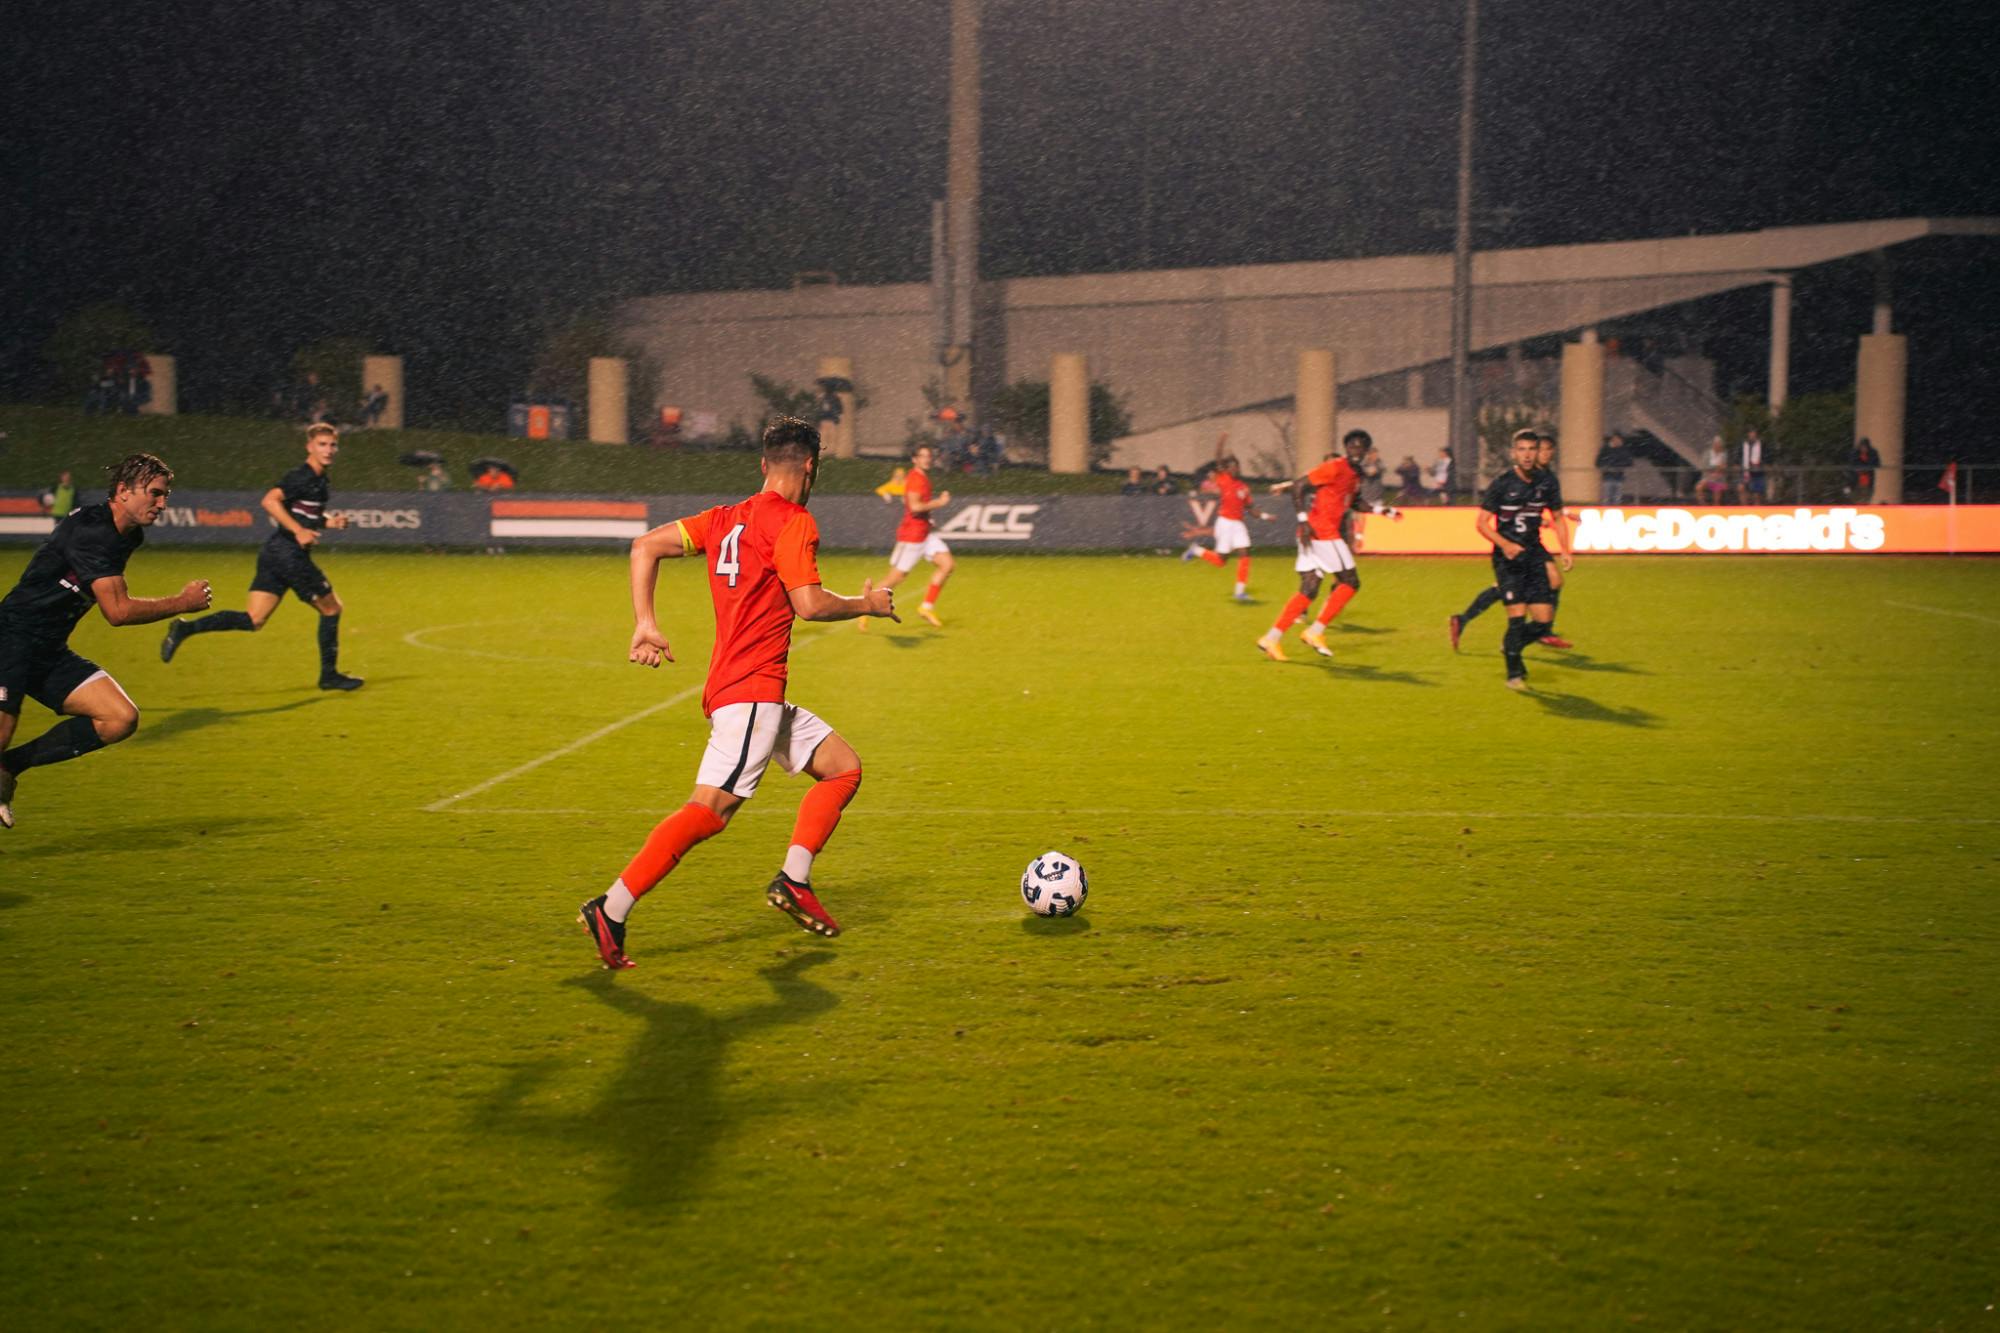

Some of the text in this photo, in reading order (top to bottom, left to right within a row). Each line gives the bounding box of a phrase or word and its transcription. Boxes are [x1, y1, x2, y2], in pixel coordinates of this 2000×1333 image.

[941, 504, 1040, 531] ACC
[1515, 516, 1527, 533] 5
[1574, 508, 1885, 550] McDonald's
[715, 523, 746, 587] 4
